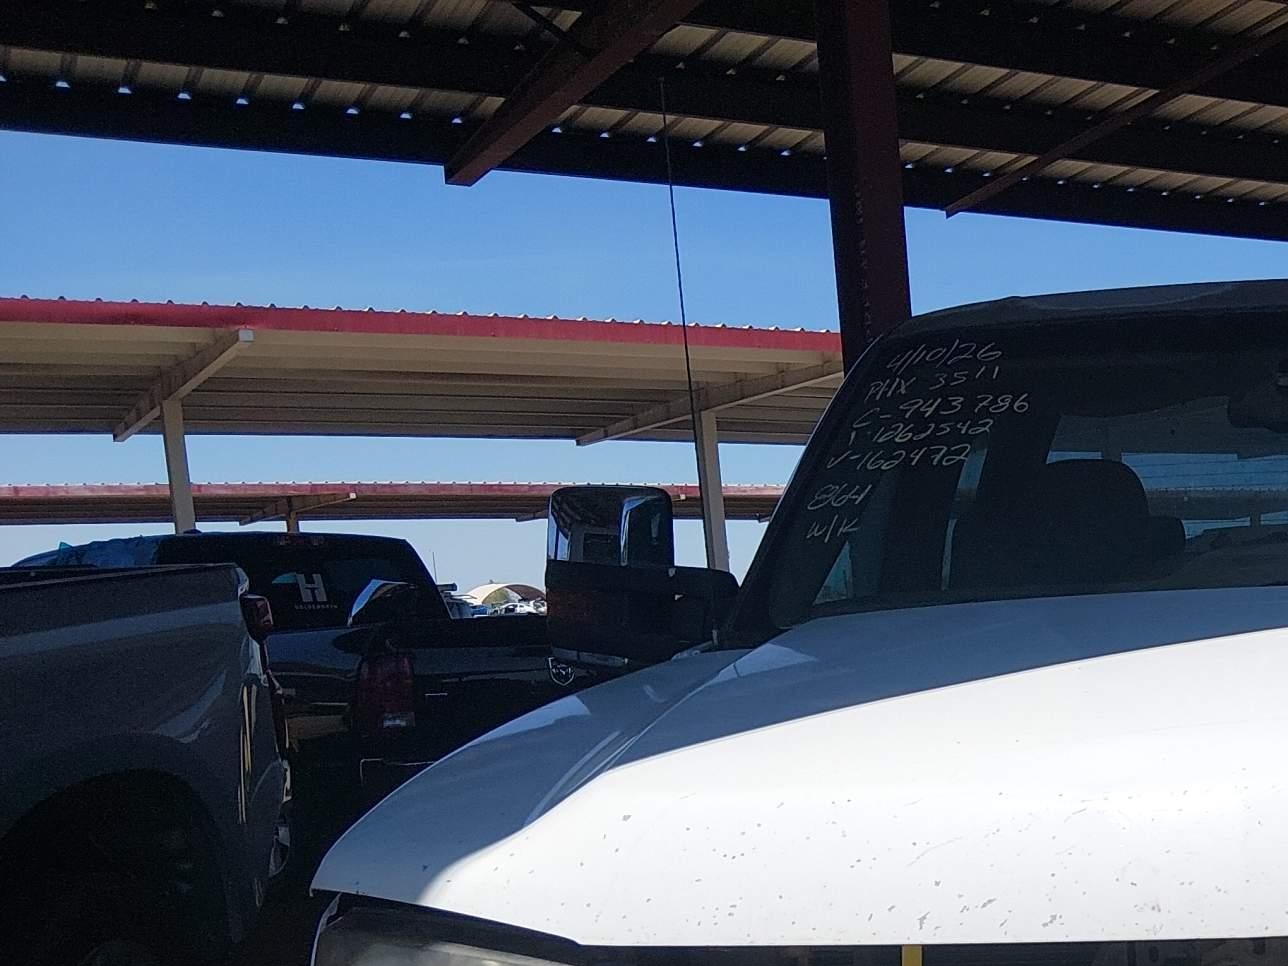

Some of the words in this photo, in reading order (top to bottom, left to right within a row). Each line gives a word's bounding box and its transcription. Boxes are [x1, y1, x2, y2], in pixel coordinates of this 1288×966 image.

[886, 338, 1003, 375] 4/10/26
[864, 376, 917, 402] PHX
[928, 365, 1000, 391] 3511
